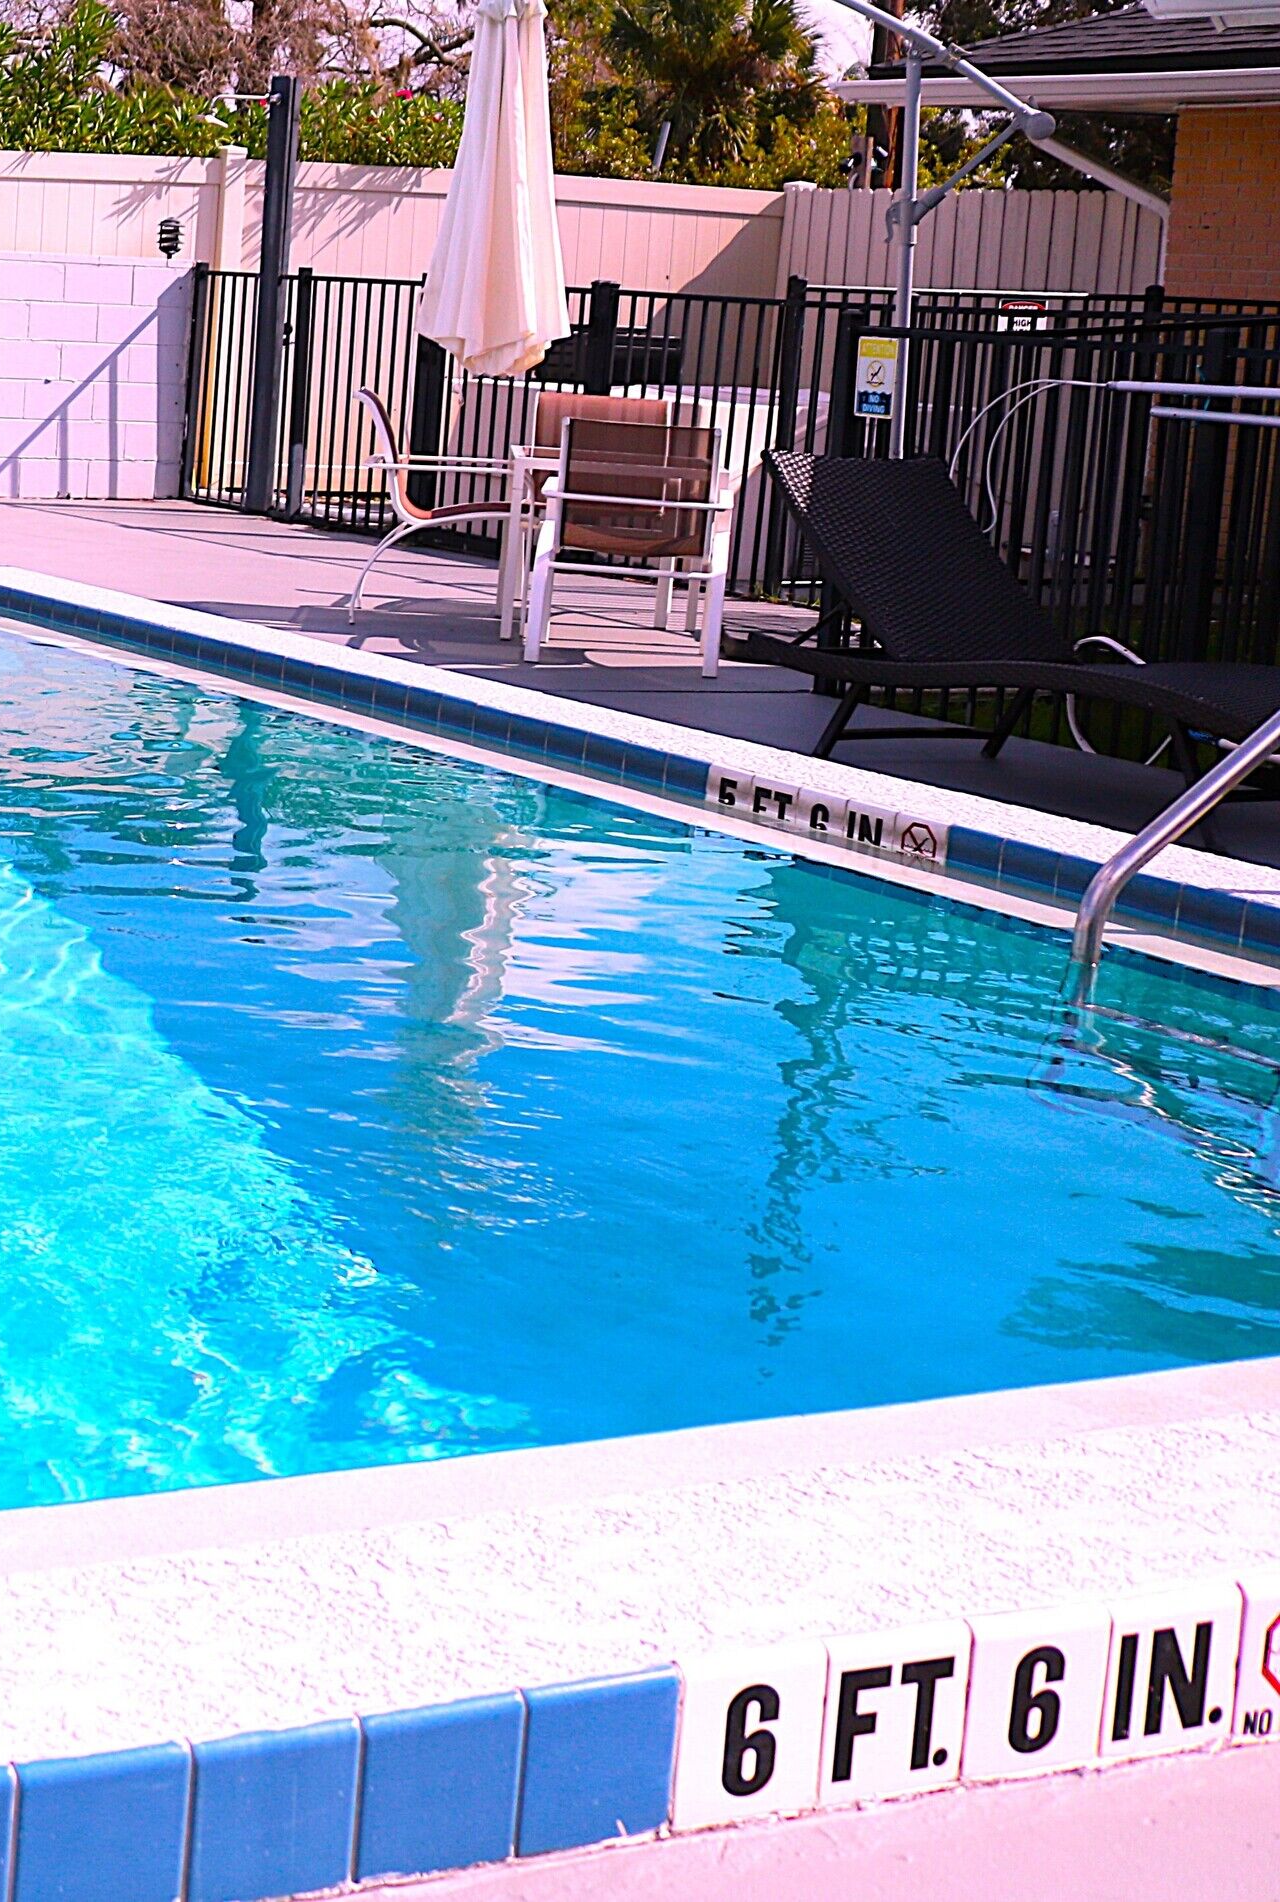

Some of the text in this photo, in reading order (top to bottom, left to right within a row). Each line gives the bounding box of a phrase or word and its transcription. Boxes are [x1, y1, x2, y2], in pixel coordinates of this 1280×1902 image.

[861, 403, 886, 413] DIVING
[868, 394, 880, 403] NO
[718, 777, 737, 806] 5
[721, 1621, 1225, 1797] 6 FT. 6 IN.
[1243, 1709, 1273, 1735] NO
